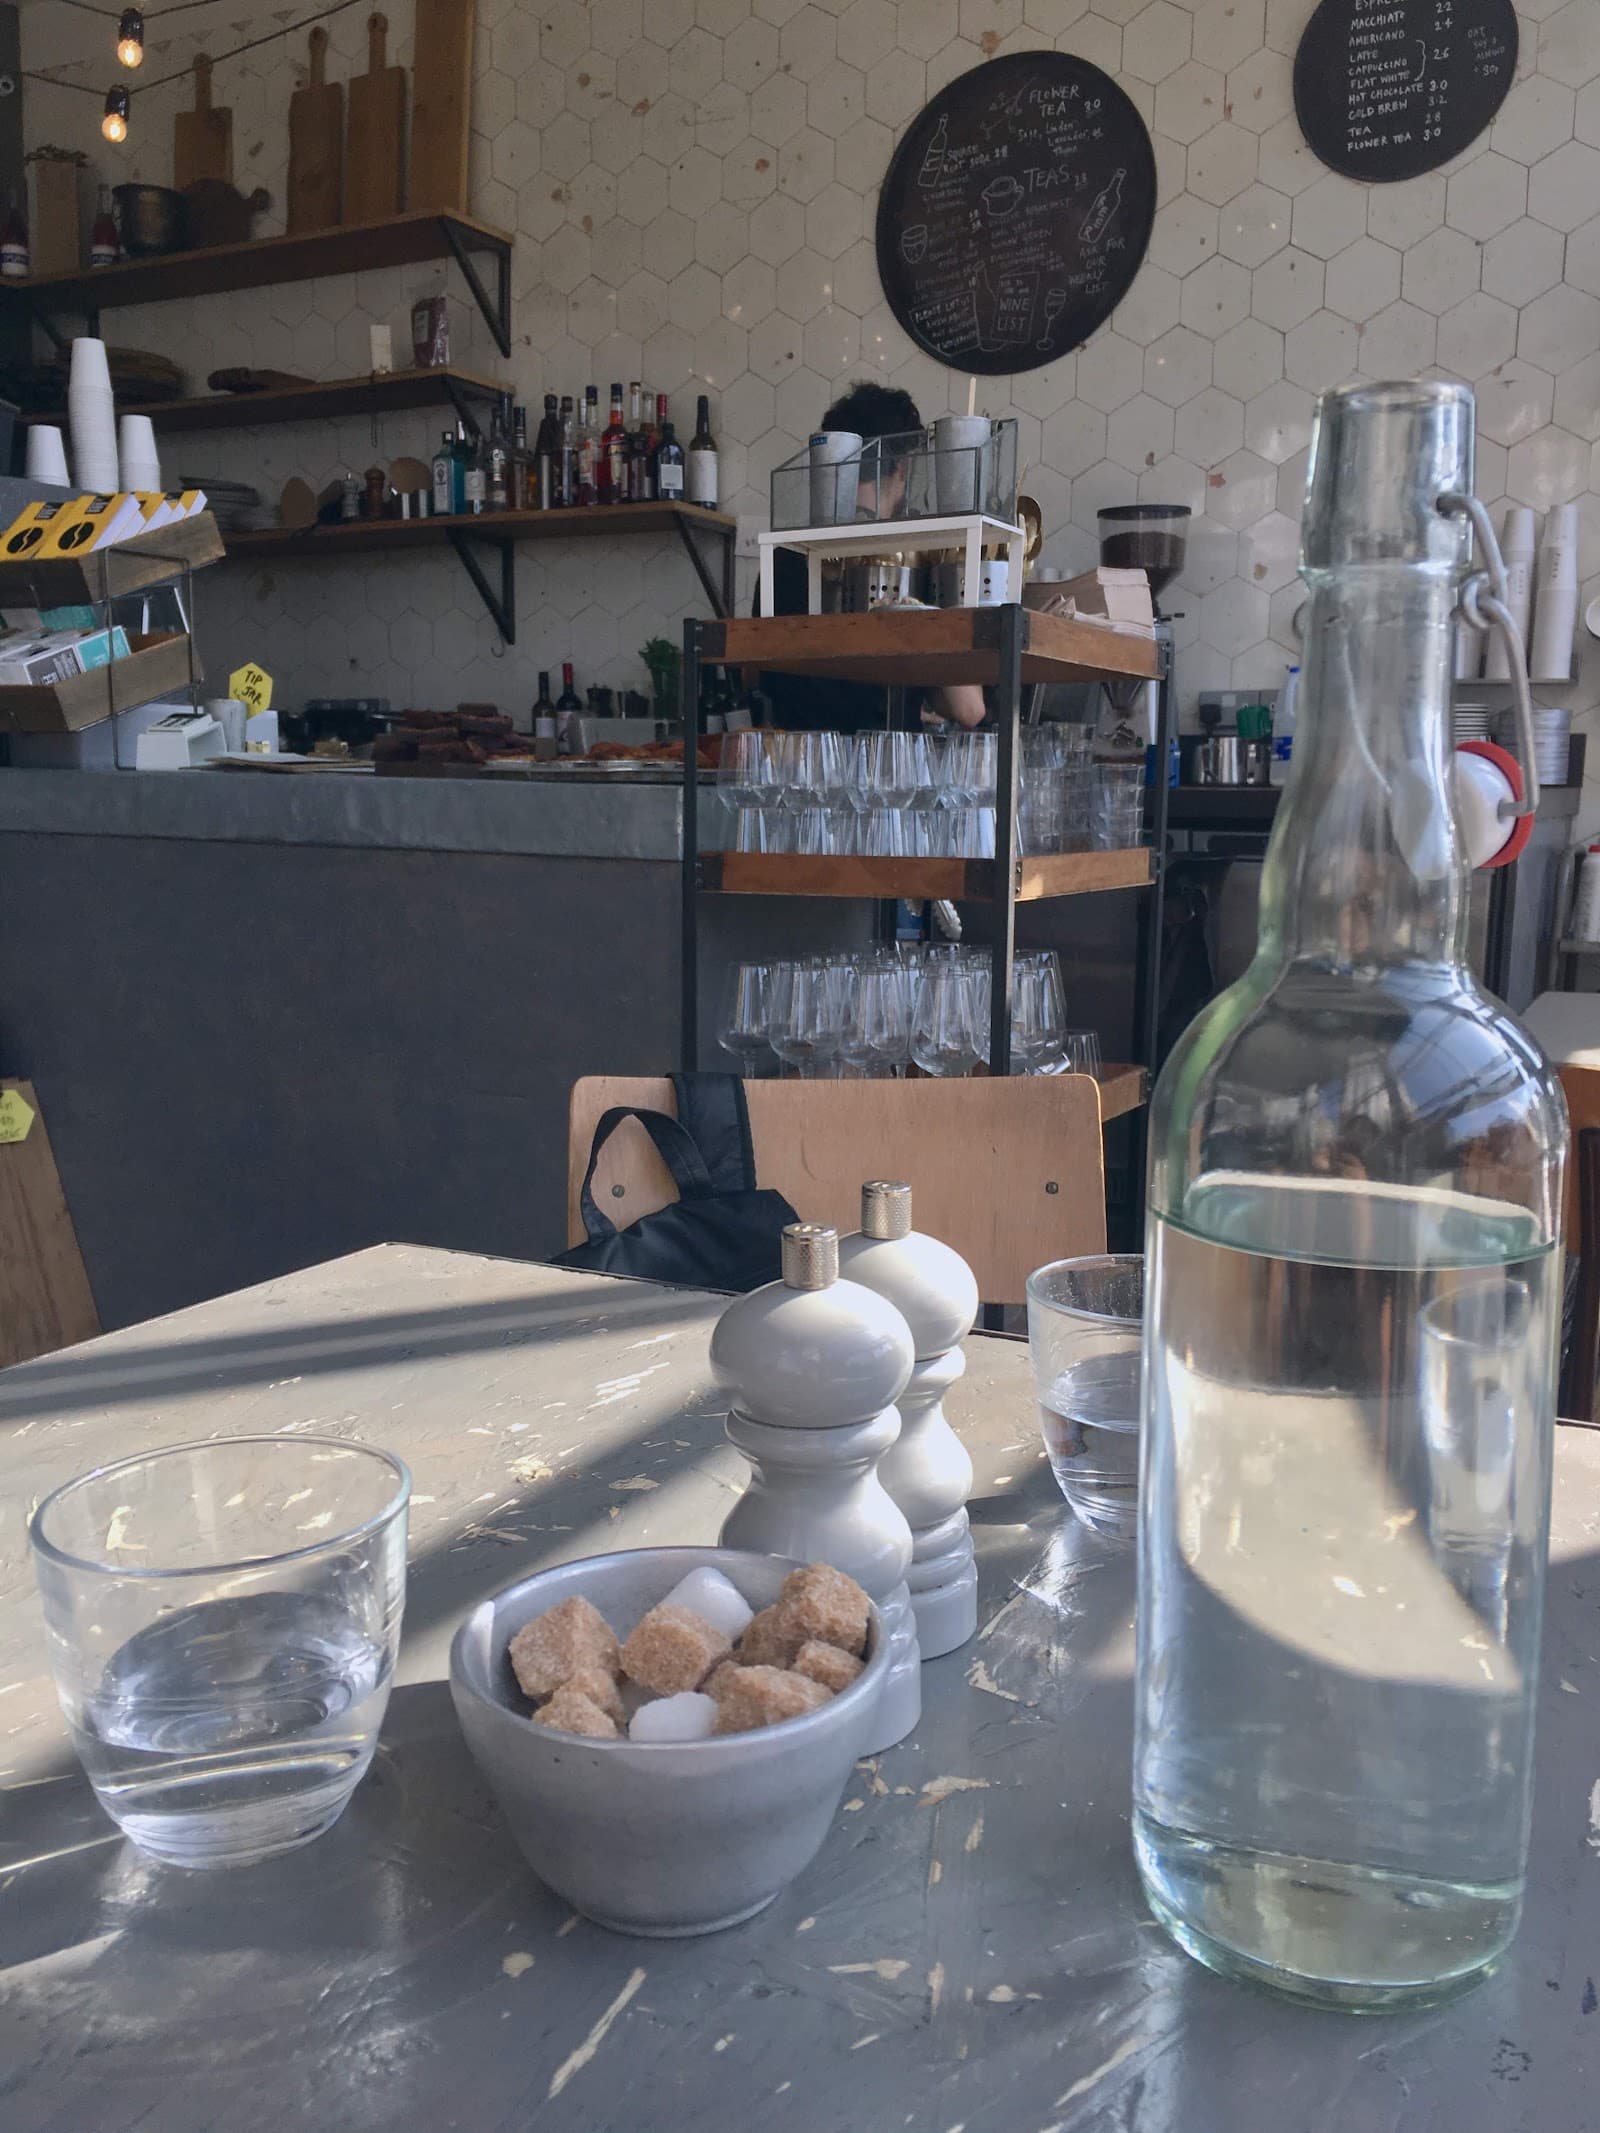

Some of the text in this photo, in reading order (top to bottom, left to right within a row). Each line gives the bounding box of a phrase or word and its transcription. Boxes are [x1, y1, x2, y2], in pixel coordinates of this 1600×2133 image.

[1350, 10, 1405, 31] MACCHIATO
[1348, 29, 1405, 47] AMERICANO
[1349, 49, 1378, 63] LATTE
[1348, 58, 1407, 76] CAPPUCCINO
[1350, 70, 1410, 89] FLAT WHITE
[1029, 84, 1081, 104] FLOWER
[1348, 79, 1448, 105] HOT CHOCOLATE 3.0
[1039, 100, 1066, 118] TEA
[1348, 106, 1375, 121] COLD
[1378, 98, 1407, 115] BREW
[1347, 126, 1371, 137] TEA
[1347, 135, 1388, 152] FLOWER
[1392, 131, 1412, 144] TEA
[1023, 163, 1070, 193] TEAS
[999, 296, 1031, 312] WINE
[997, 316, 1027, 331] LIST
[245, 670, 263, 686] TIP
[241, 686, 263, 705] JAR
